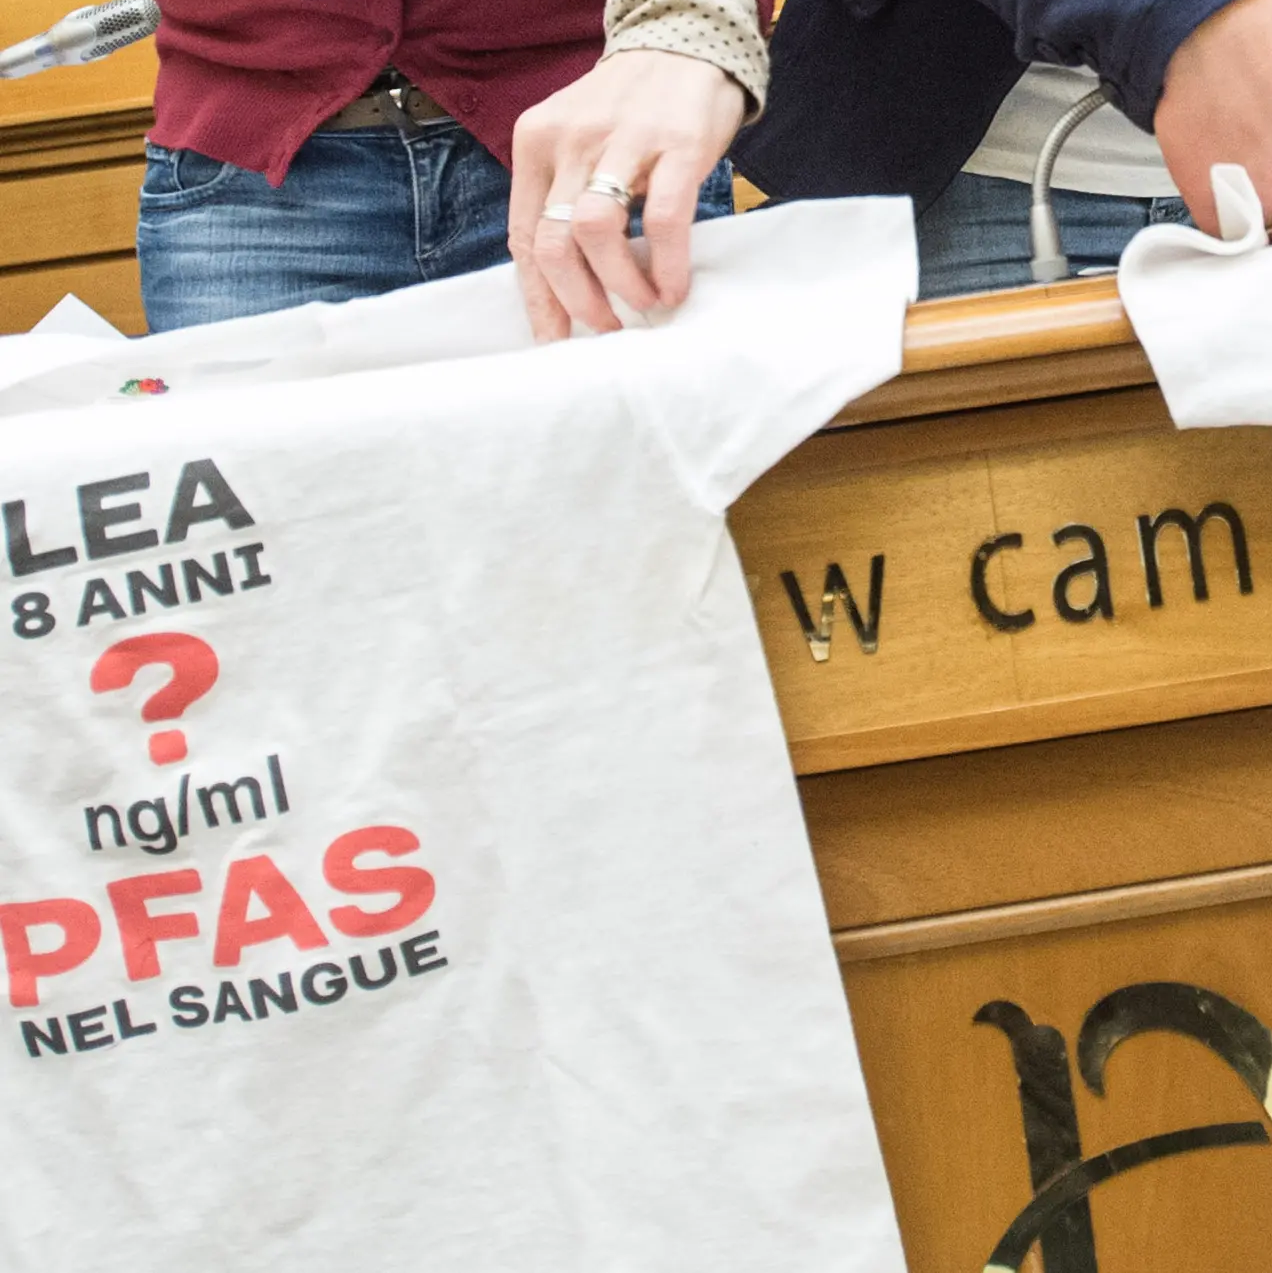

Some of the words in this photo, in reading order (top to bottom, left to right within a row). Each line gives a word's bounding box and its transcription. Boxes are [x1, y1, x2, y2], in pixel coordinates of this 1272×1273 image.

[1, 459, 255, 577] LEA
[12, 592, 55, 639] 8
[78, 543, 271, 626] ANNI
[91, 633, 218, 765] ?
[84, 755, 290, 855] ng/ml
[0, 826, 435, 1007] PFAS
[18, 999, 157, 1057] NEL
[168, 930, 449, 1028] SANGUE
